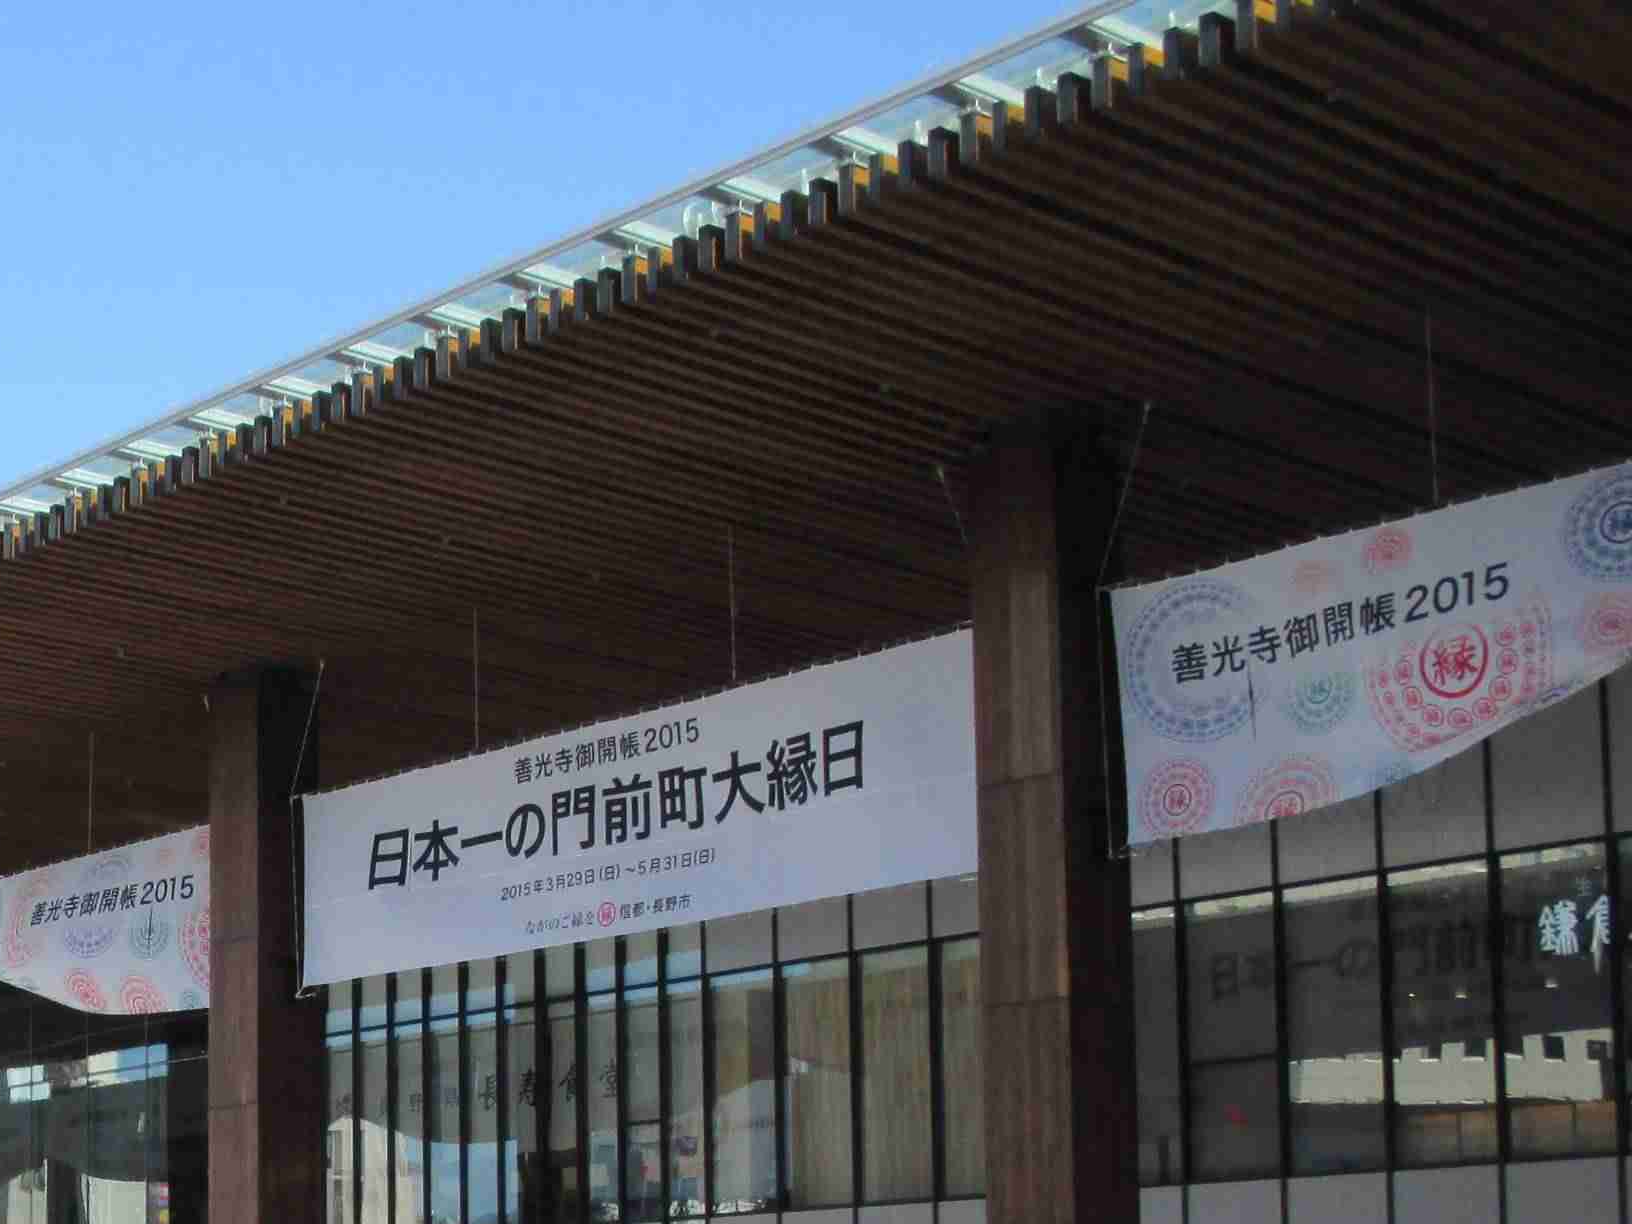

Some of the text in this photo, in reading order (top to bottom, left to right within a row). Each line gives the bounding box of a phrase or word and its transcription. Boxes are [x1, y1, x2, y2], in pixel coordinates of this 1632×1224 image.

[1171, 562, 1509, 685] 善光寺御開帳2015
[514, 717, 700, 784] 善光寺御開帳2015
[368, 719, 865, 890] 日本一の門前町大縁日
[29, 873, 195, 927] 善光寺御開帳2015
